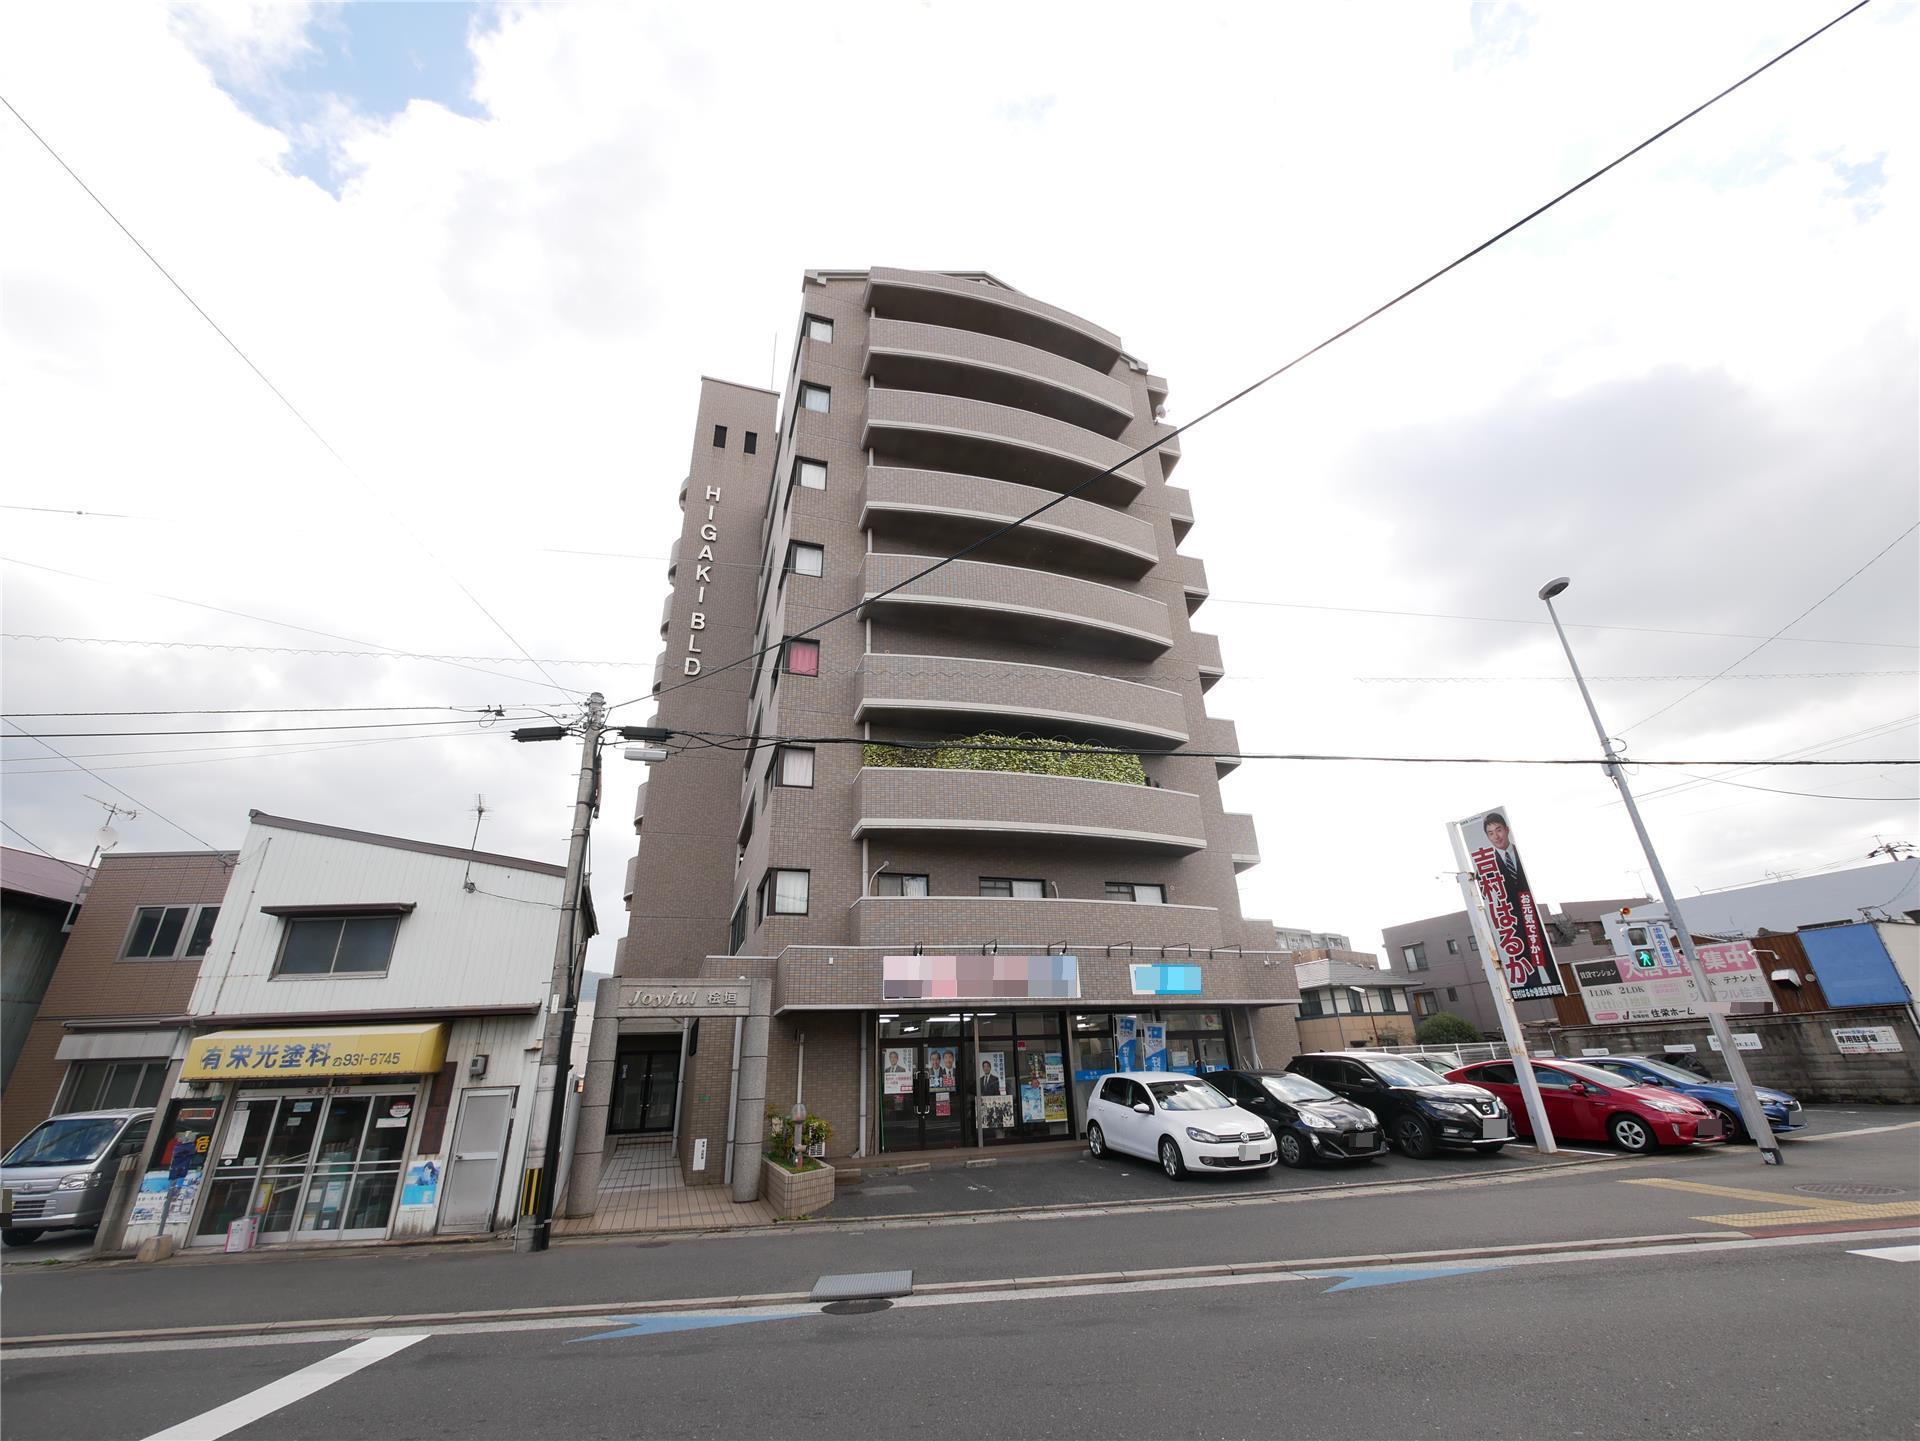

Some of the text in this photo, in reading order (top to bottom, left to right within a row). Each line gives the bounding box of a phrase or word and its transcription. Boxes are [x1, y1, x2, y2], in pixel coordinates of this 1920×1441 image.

[684, 485, 721, 677] HIGAKI BLD
[1471, 847, 1535, 985] 吉村はるか
[1723, 973, 1758, 985] テナント
[628, 990, 737, 1008] Joyful 桧垣
[1589, 988, 1613, 997] 1LDK
[1619, 985, 1645, 995] 2LDK
[342, 1052, 401, 1067] 931-6745
